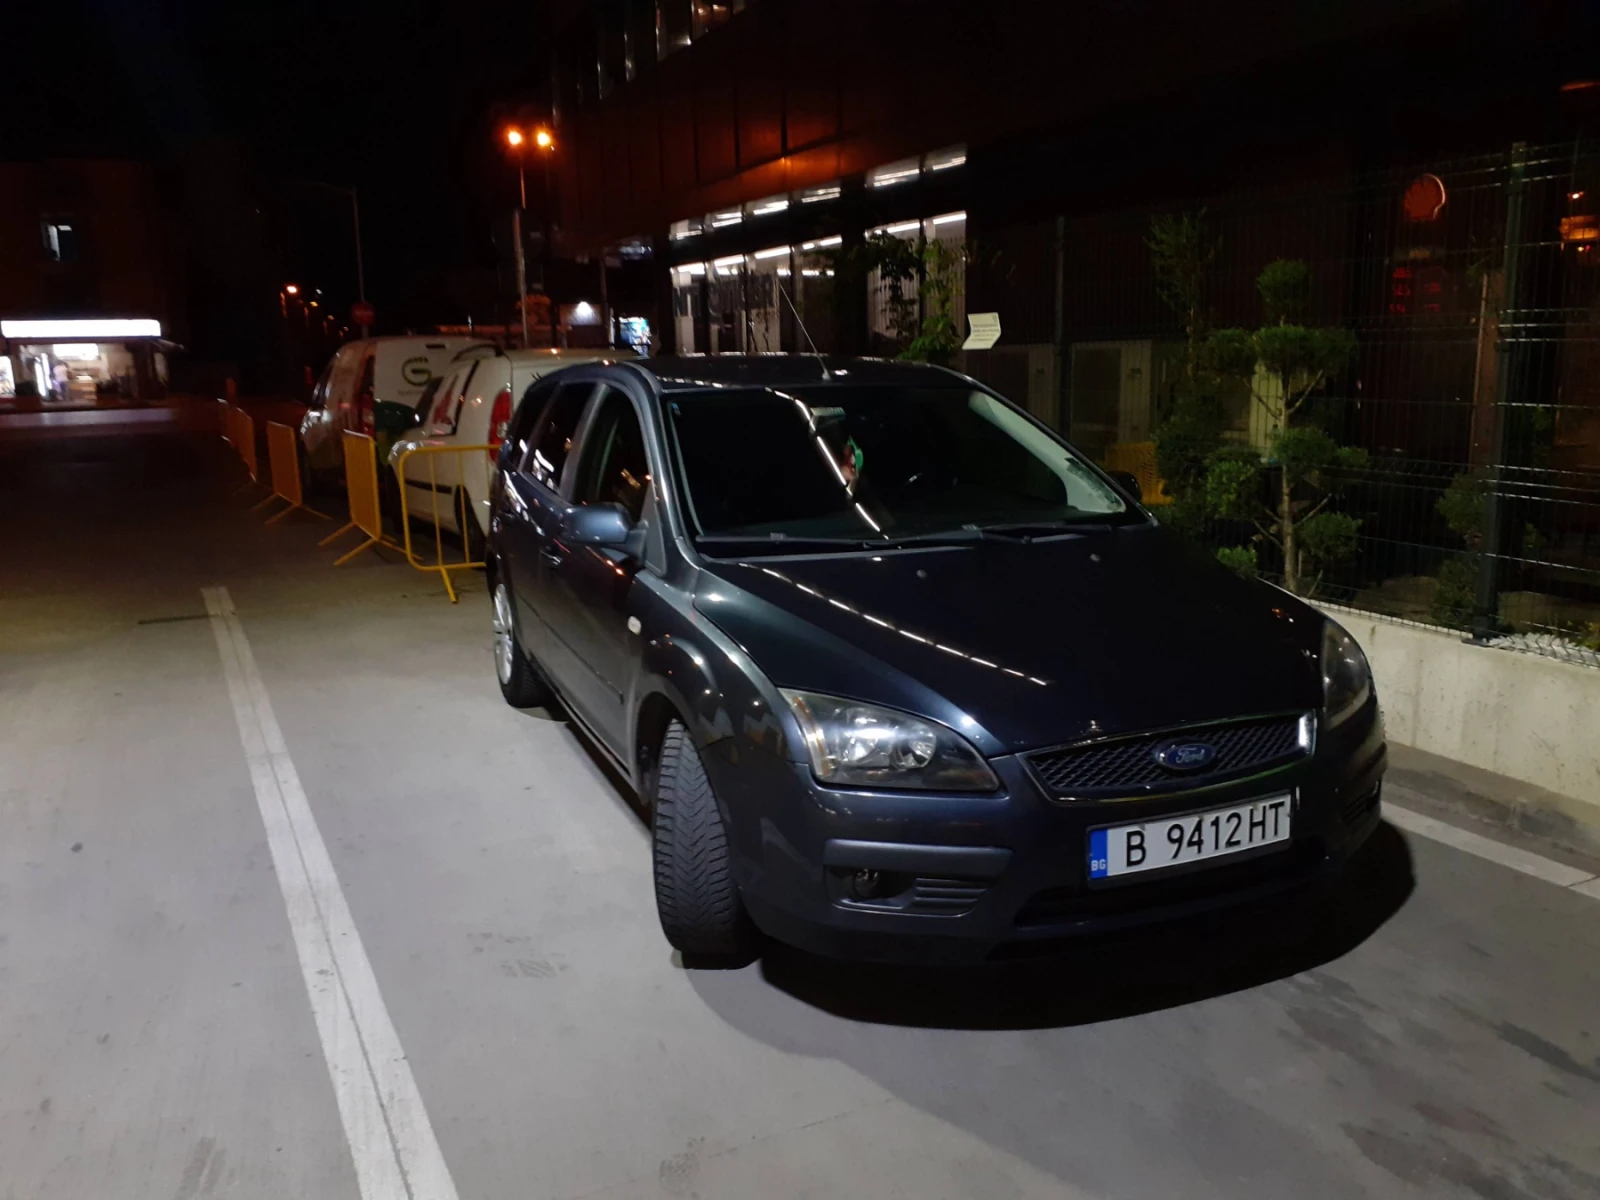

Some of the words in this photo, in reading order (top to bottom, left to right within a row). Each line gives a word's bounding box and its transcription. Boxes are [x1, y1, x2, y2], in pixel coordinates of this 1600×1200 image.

[1175, 747, 1206, 764] Ford
[1126, 830, 1147, 867] B
[1090, 859, 1107, 872] BG
